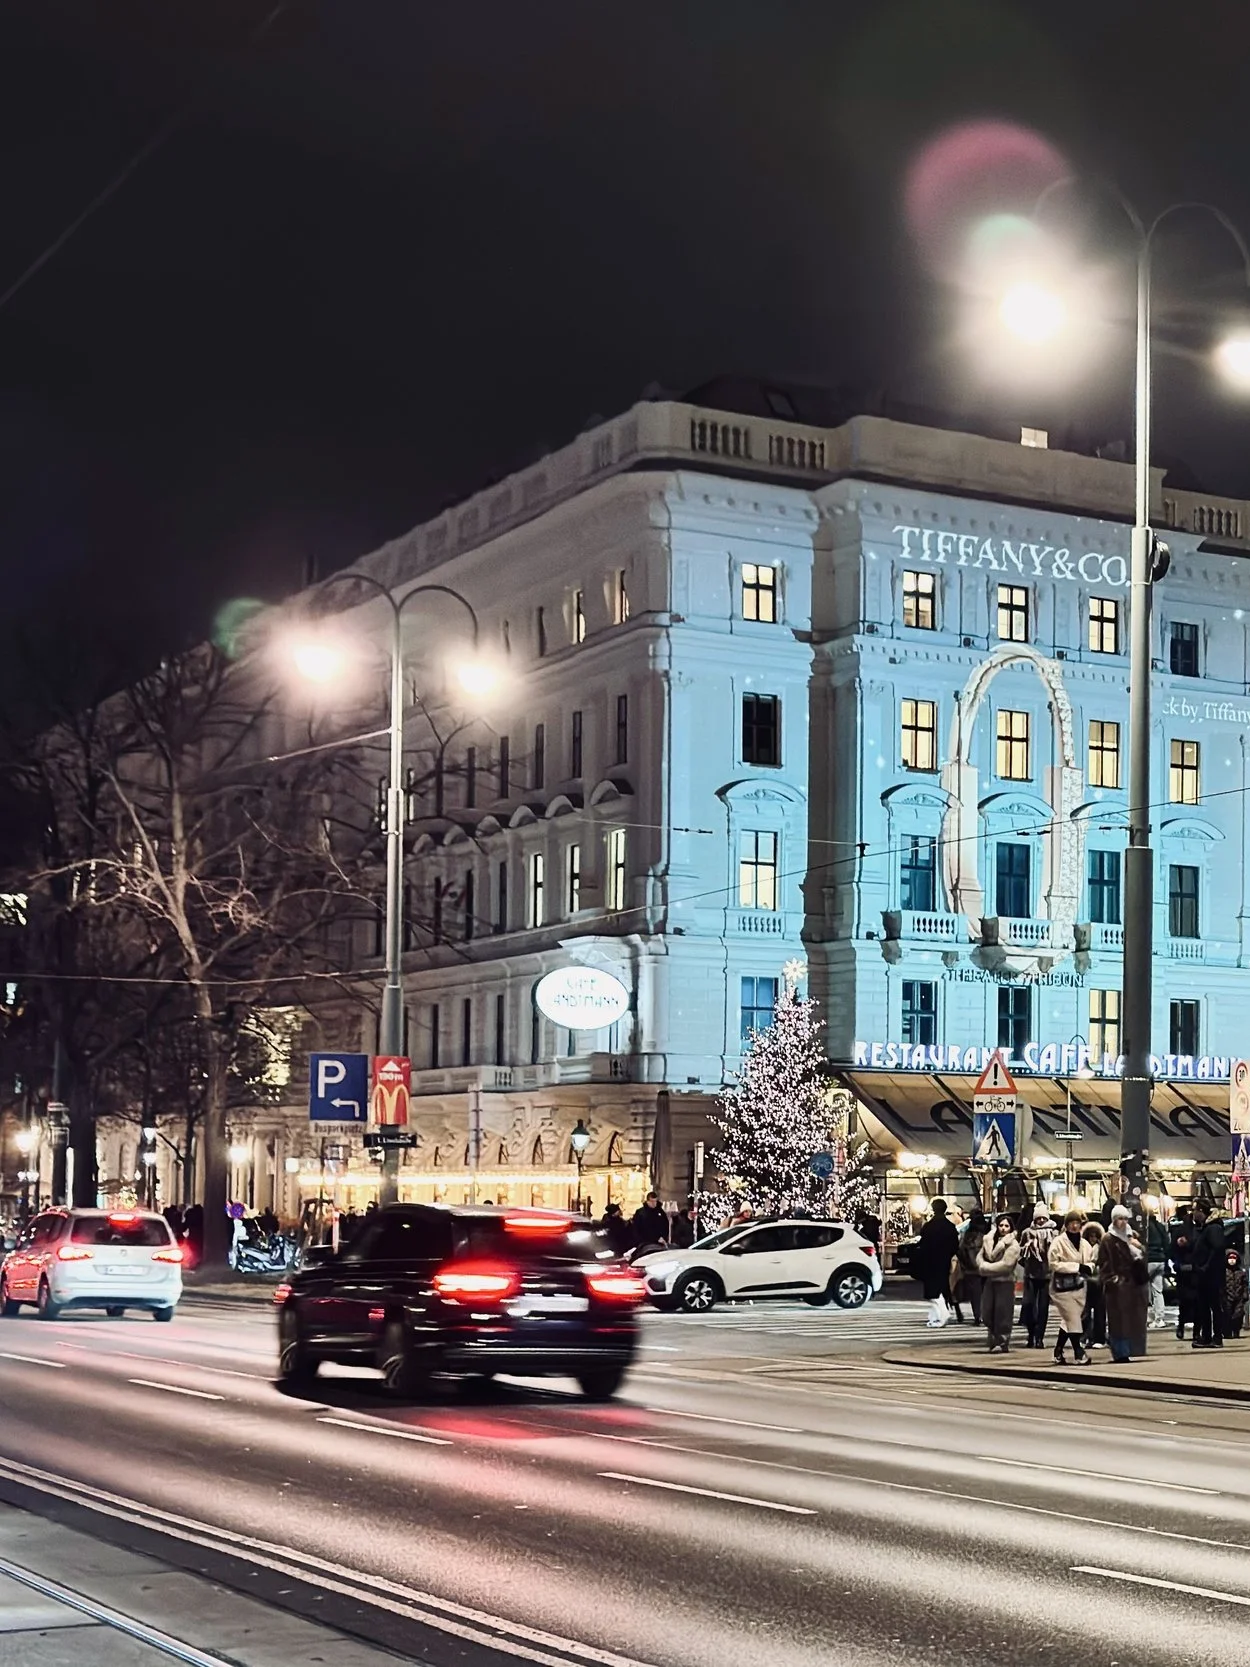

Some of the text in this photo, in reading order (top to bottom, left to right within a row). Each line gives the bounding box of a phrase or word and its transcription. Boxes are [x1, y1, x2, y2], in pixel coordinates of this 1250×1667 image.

[1181, 698, 1198, 723] by
[854, 1041, 1014, 1072] RESTAURANT
[317, 1059, 347, 1098] P
